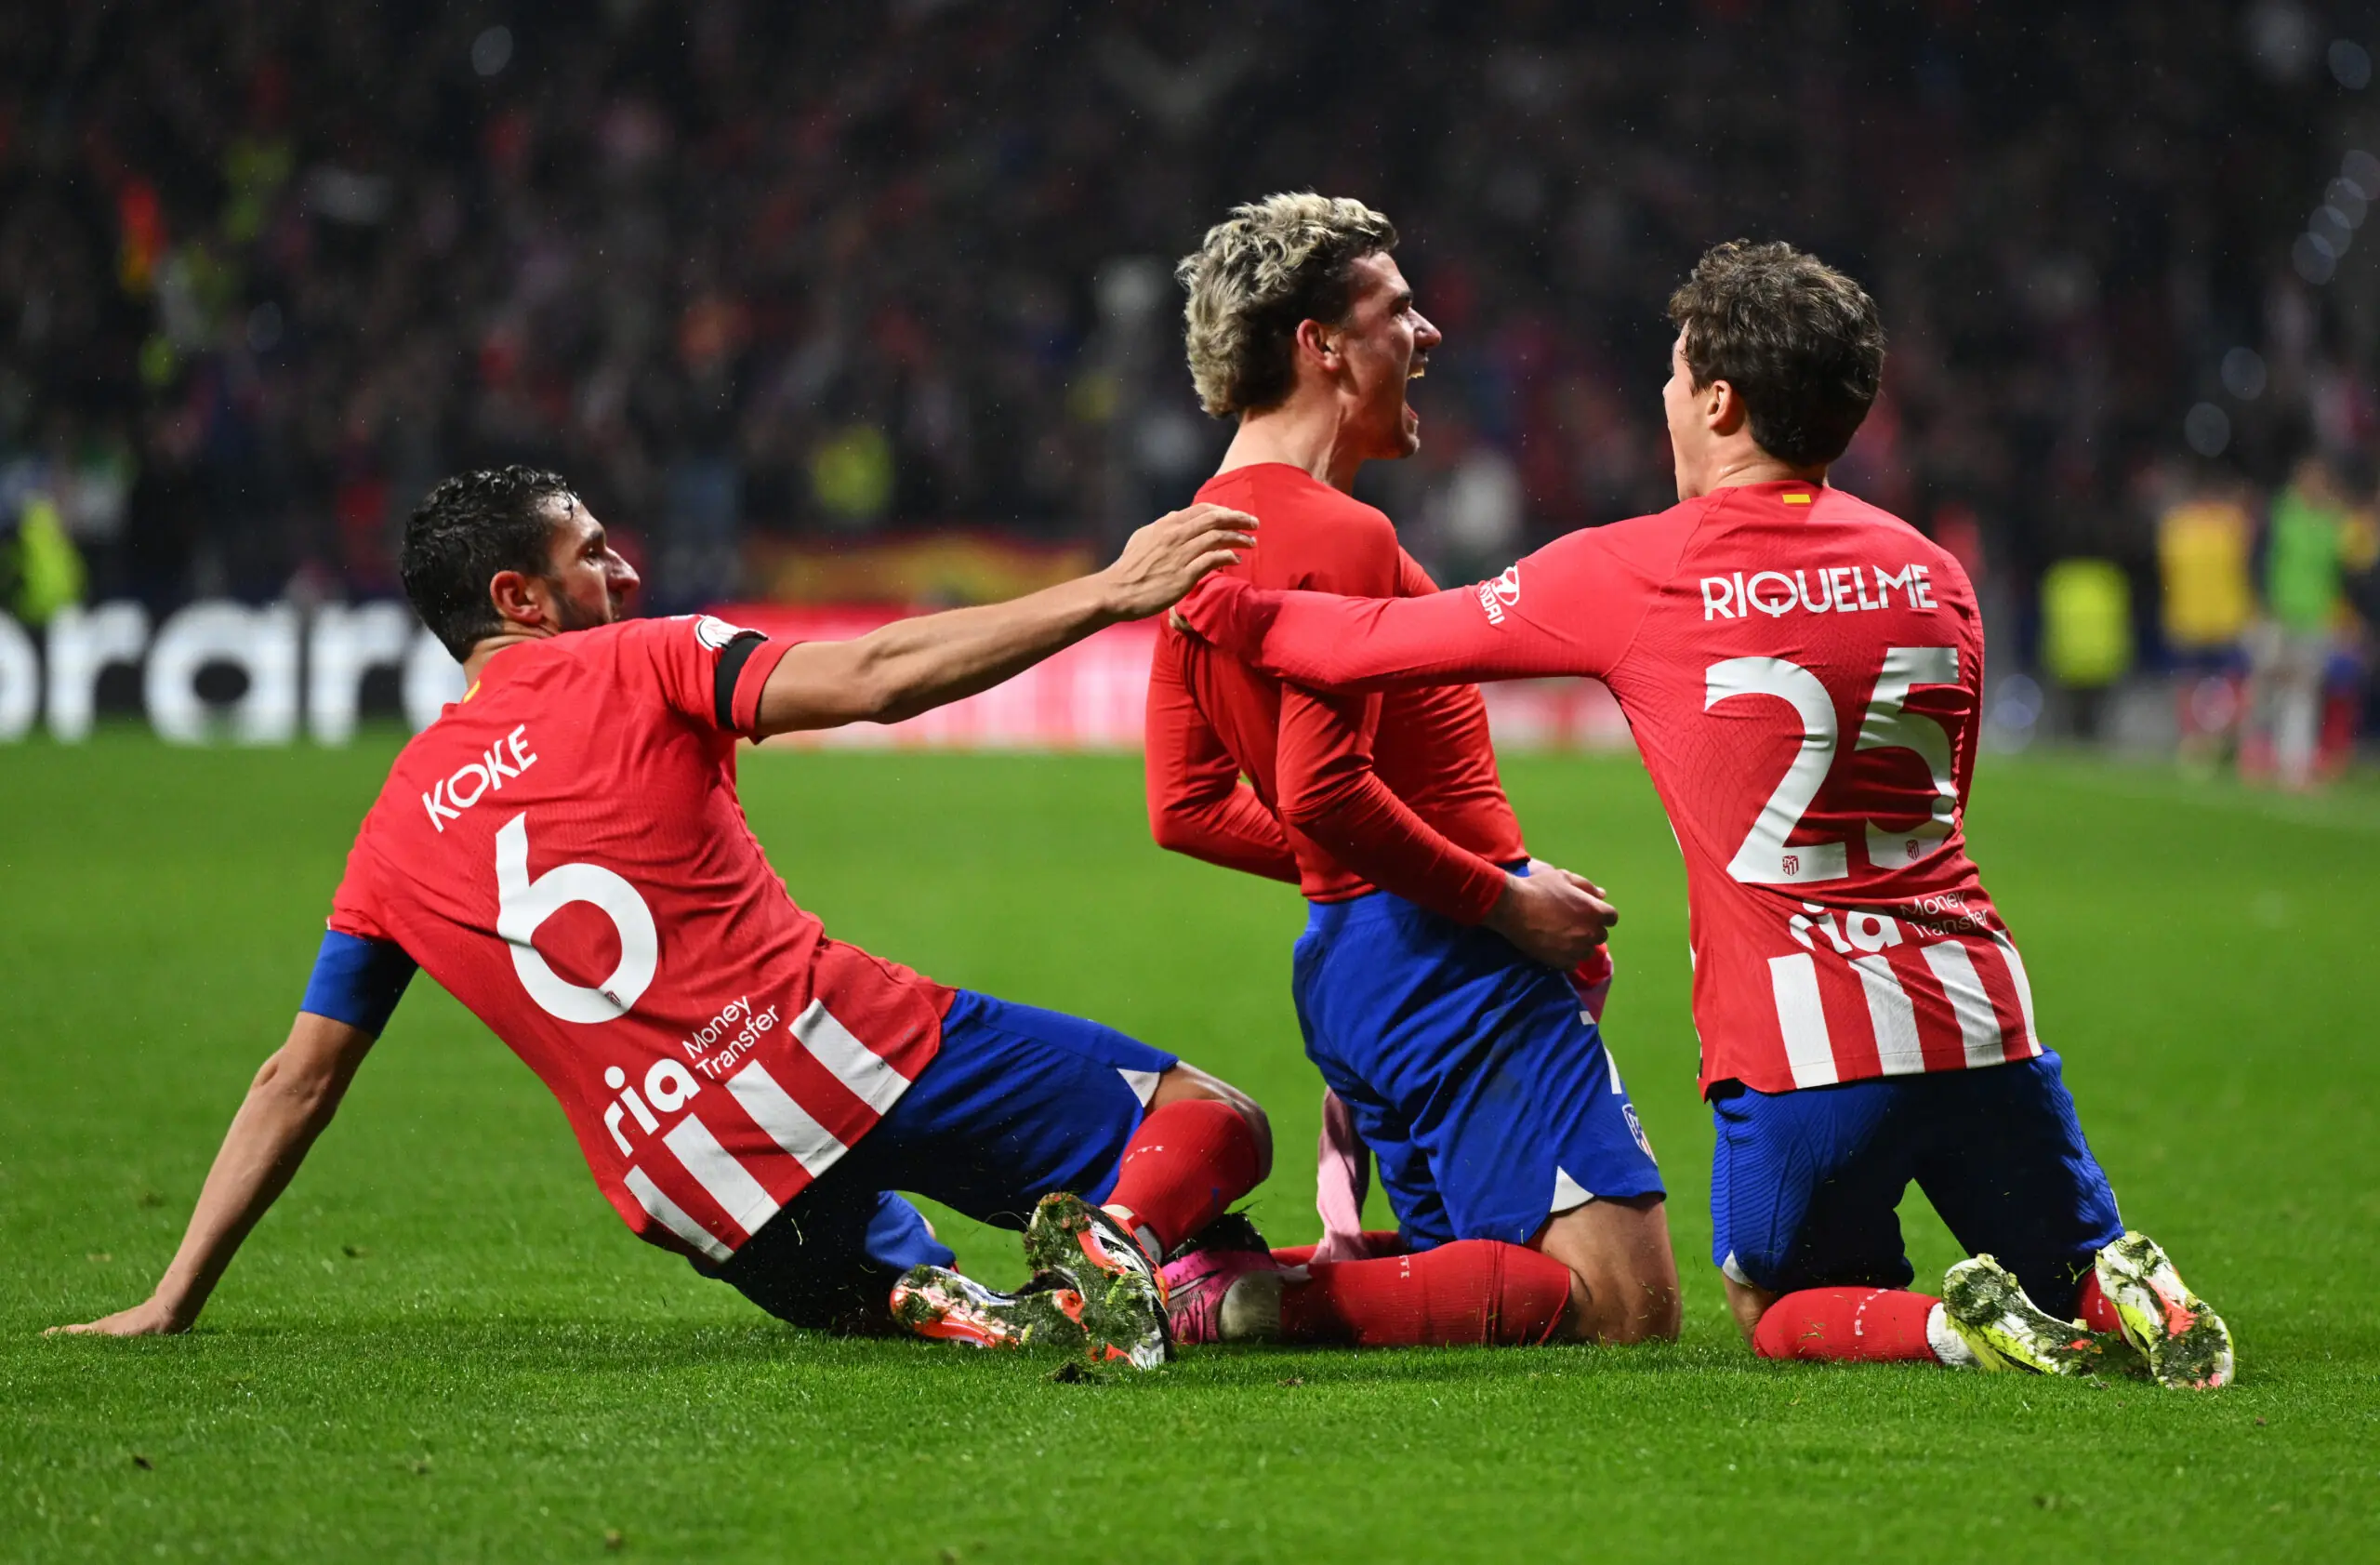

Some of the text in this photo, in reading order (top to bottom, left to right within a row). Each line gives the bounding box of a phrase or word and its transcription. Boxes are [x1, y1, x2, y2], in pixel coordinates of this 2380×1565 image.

[1699, 563, 1939, 622] RIQUELME
[0, 600, 468, 747] rar
[421, 723, 538, 833] KOKE
[1704, 646, 1960, 884] 25
[495, 811, 658, 1024] 6
[1789, 898, 1903, 954] ria
[1899, 890, 1967, 917] Money
[1907, 907, 1989, 938] Transfer
[681, 995, 753, 1061] Money
[694, 1004, 781, 1081] Transfer
[603, 1057, 702, 1159] ria
